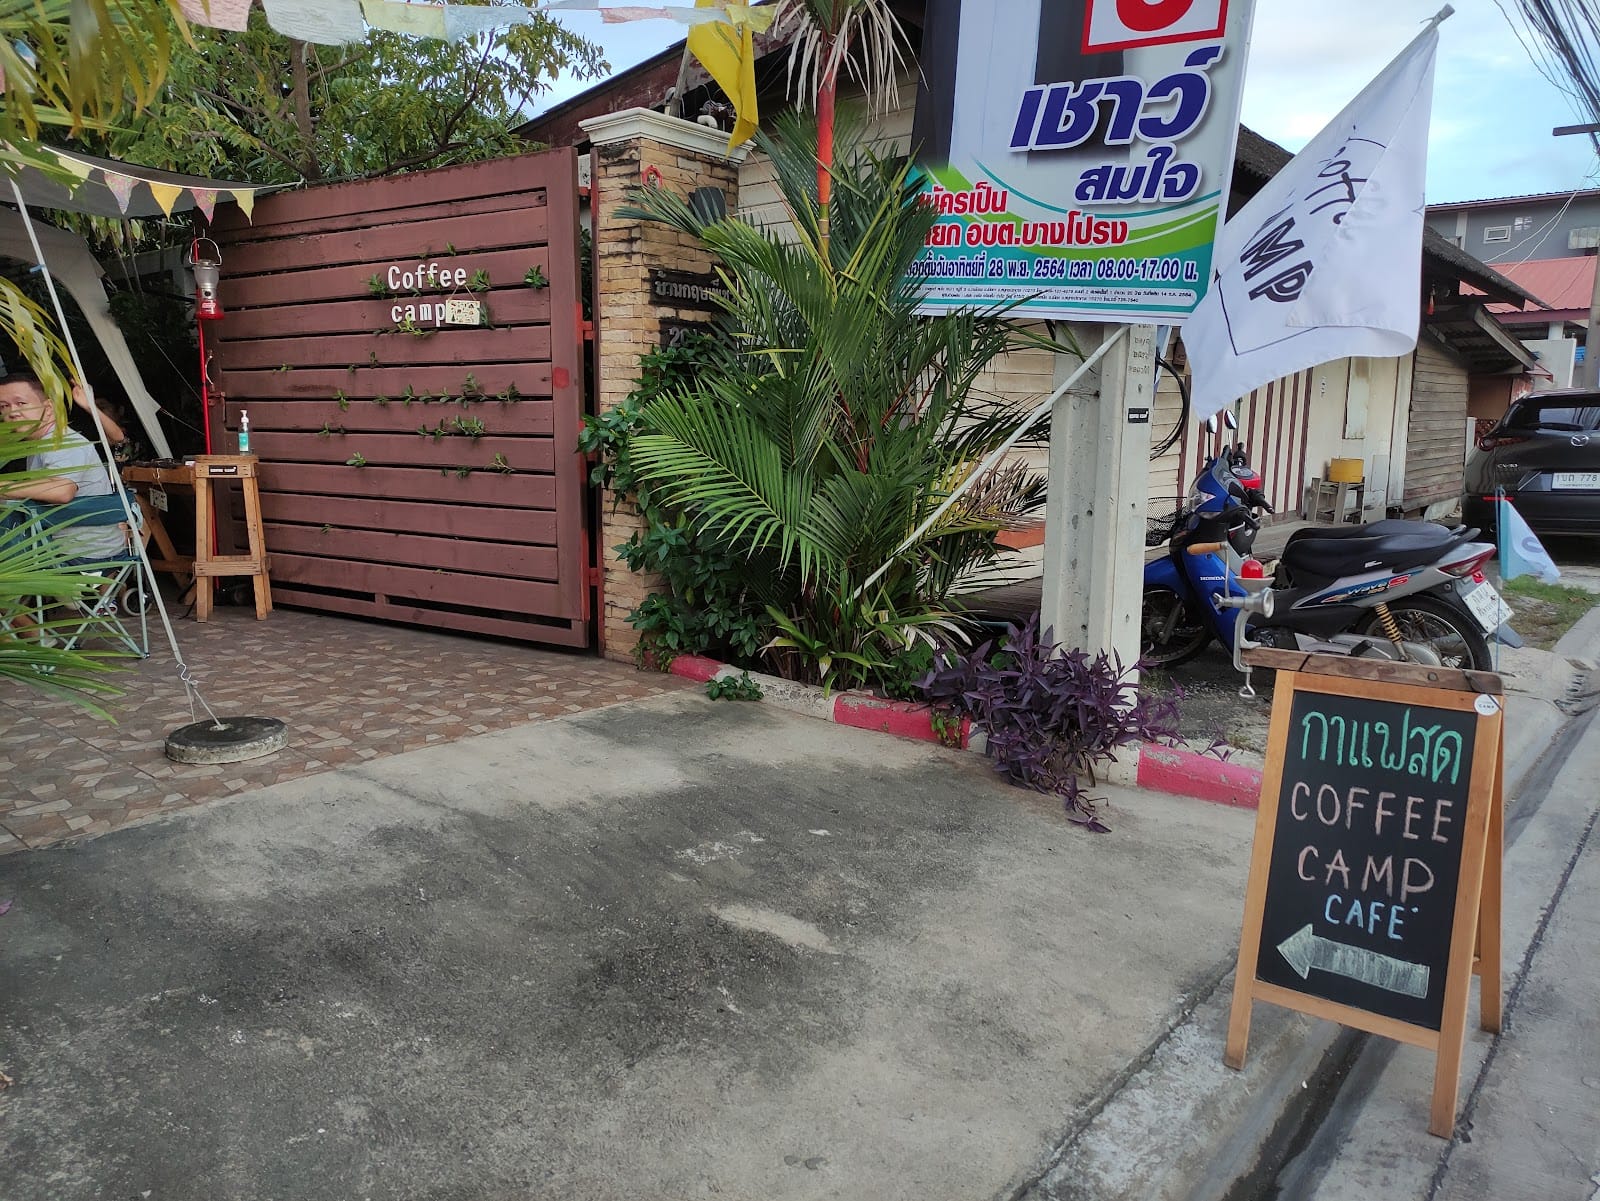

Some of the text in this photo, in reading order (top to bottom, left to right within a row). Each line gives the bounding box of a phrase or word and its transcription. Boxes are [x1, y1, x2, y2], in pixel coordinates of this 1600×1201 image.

[1010, 46, 1221, 148] เชาว์
[1075, 146, 1198, 200] สมใจ
[388, 263, 467, 290] Coffee
[988, 259, 1004, 277] 28
[1008, 261, 1030, 277] พ.ย.
[1035, 259, 1065, 277] 2564
[1069, 261, 1093, 278] เวลา
[1097, 259, 1180, 280] 08.00-17.00
[1185, 262, 1198, 280] น.
[391, 303, 446, 327] camp
[1301, 708, 1463, 784] กาแฟสด
[1290, 781, 1454, 843] COFFEE
[1297, 845, 1435, 901] CAMP
